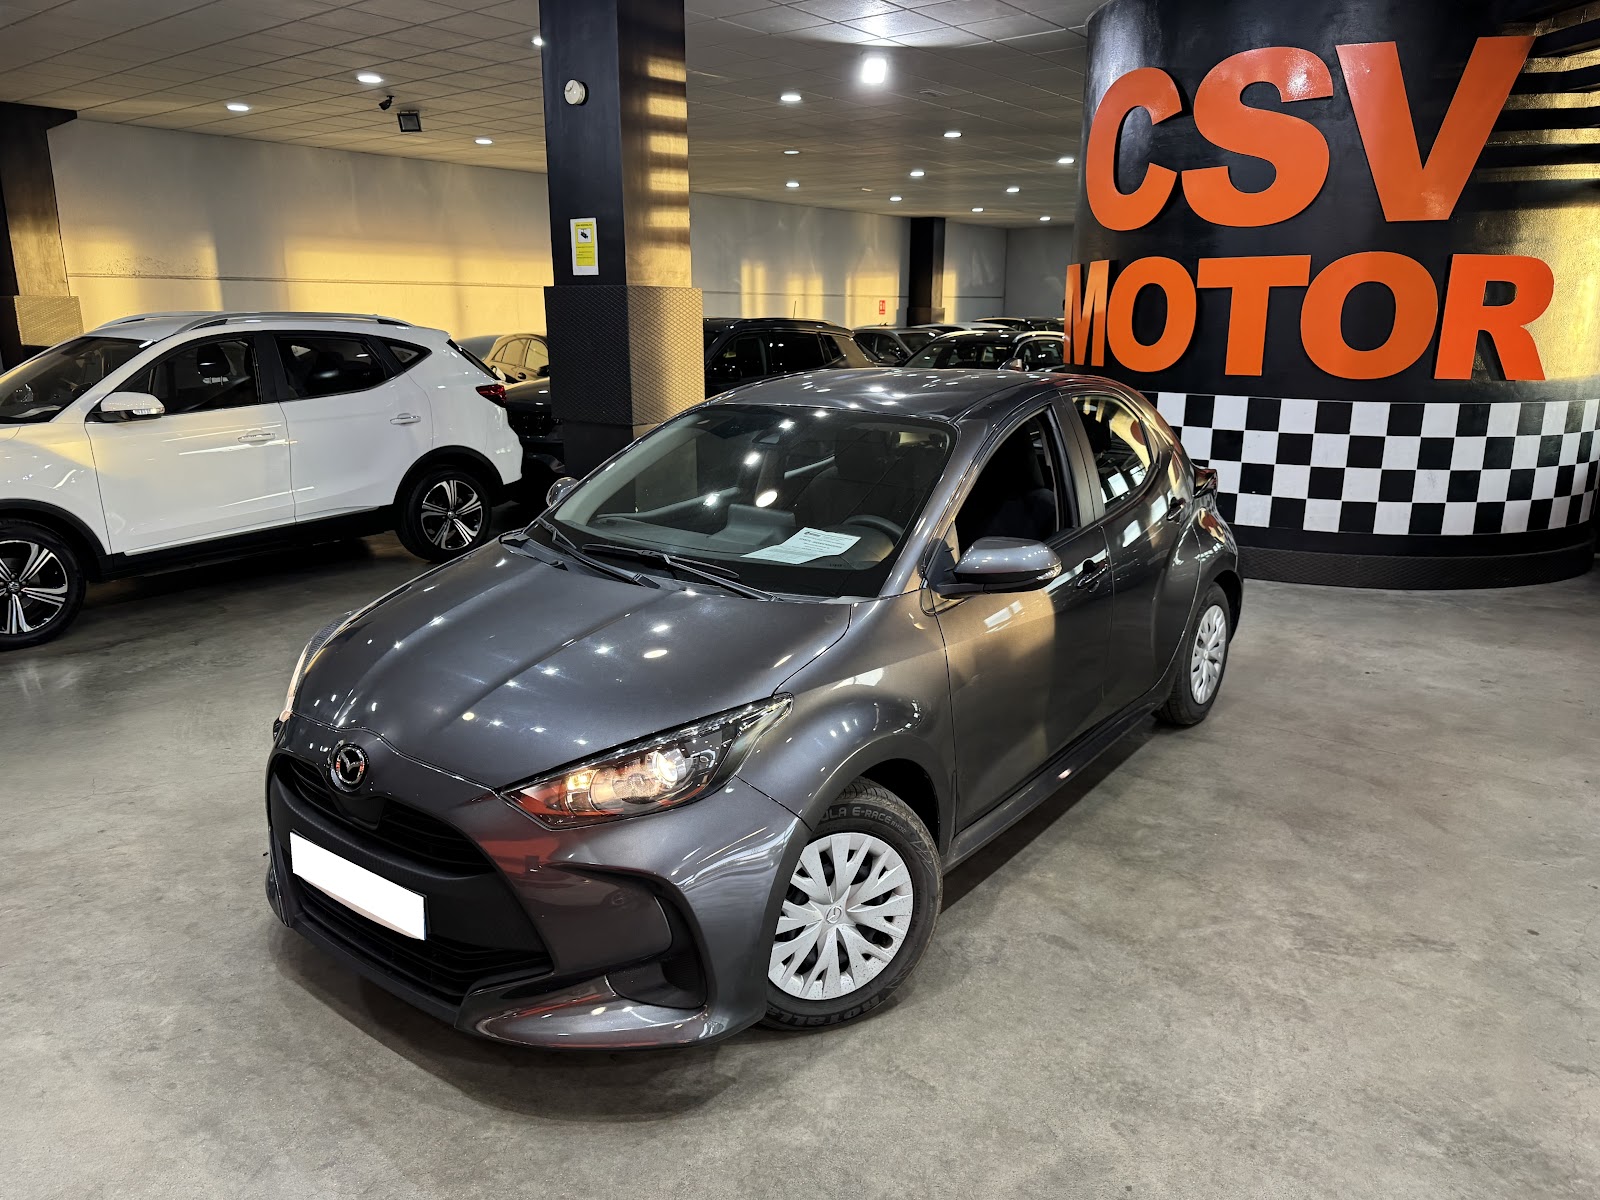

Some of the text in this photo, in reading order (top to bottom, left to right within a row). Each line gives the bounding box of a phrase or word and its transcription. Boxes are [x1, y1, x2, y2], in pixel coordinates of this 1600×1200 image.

[1086, 36, 1537, 231] CSV
[1063, 251, 1554, 381] MOTOR
[852, 806, 892, 824] E-RACE
